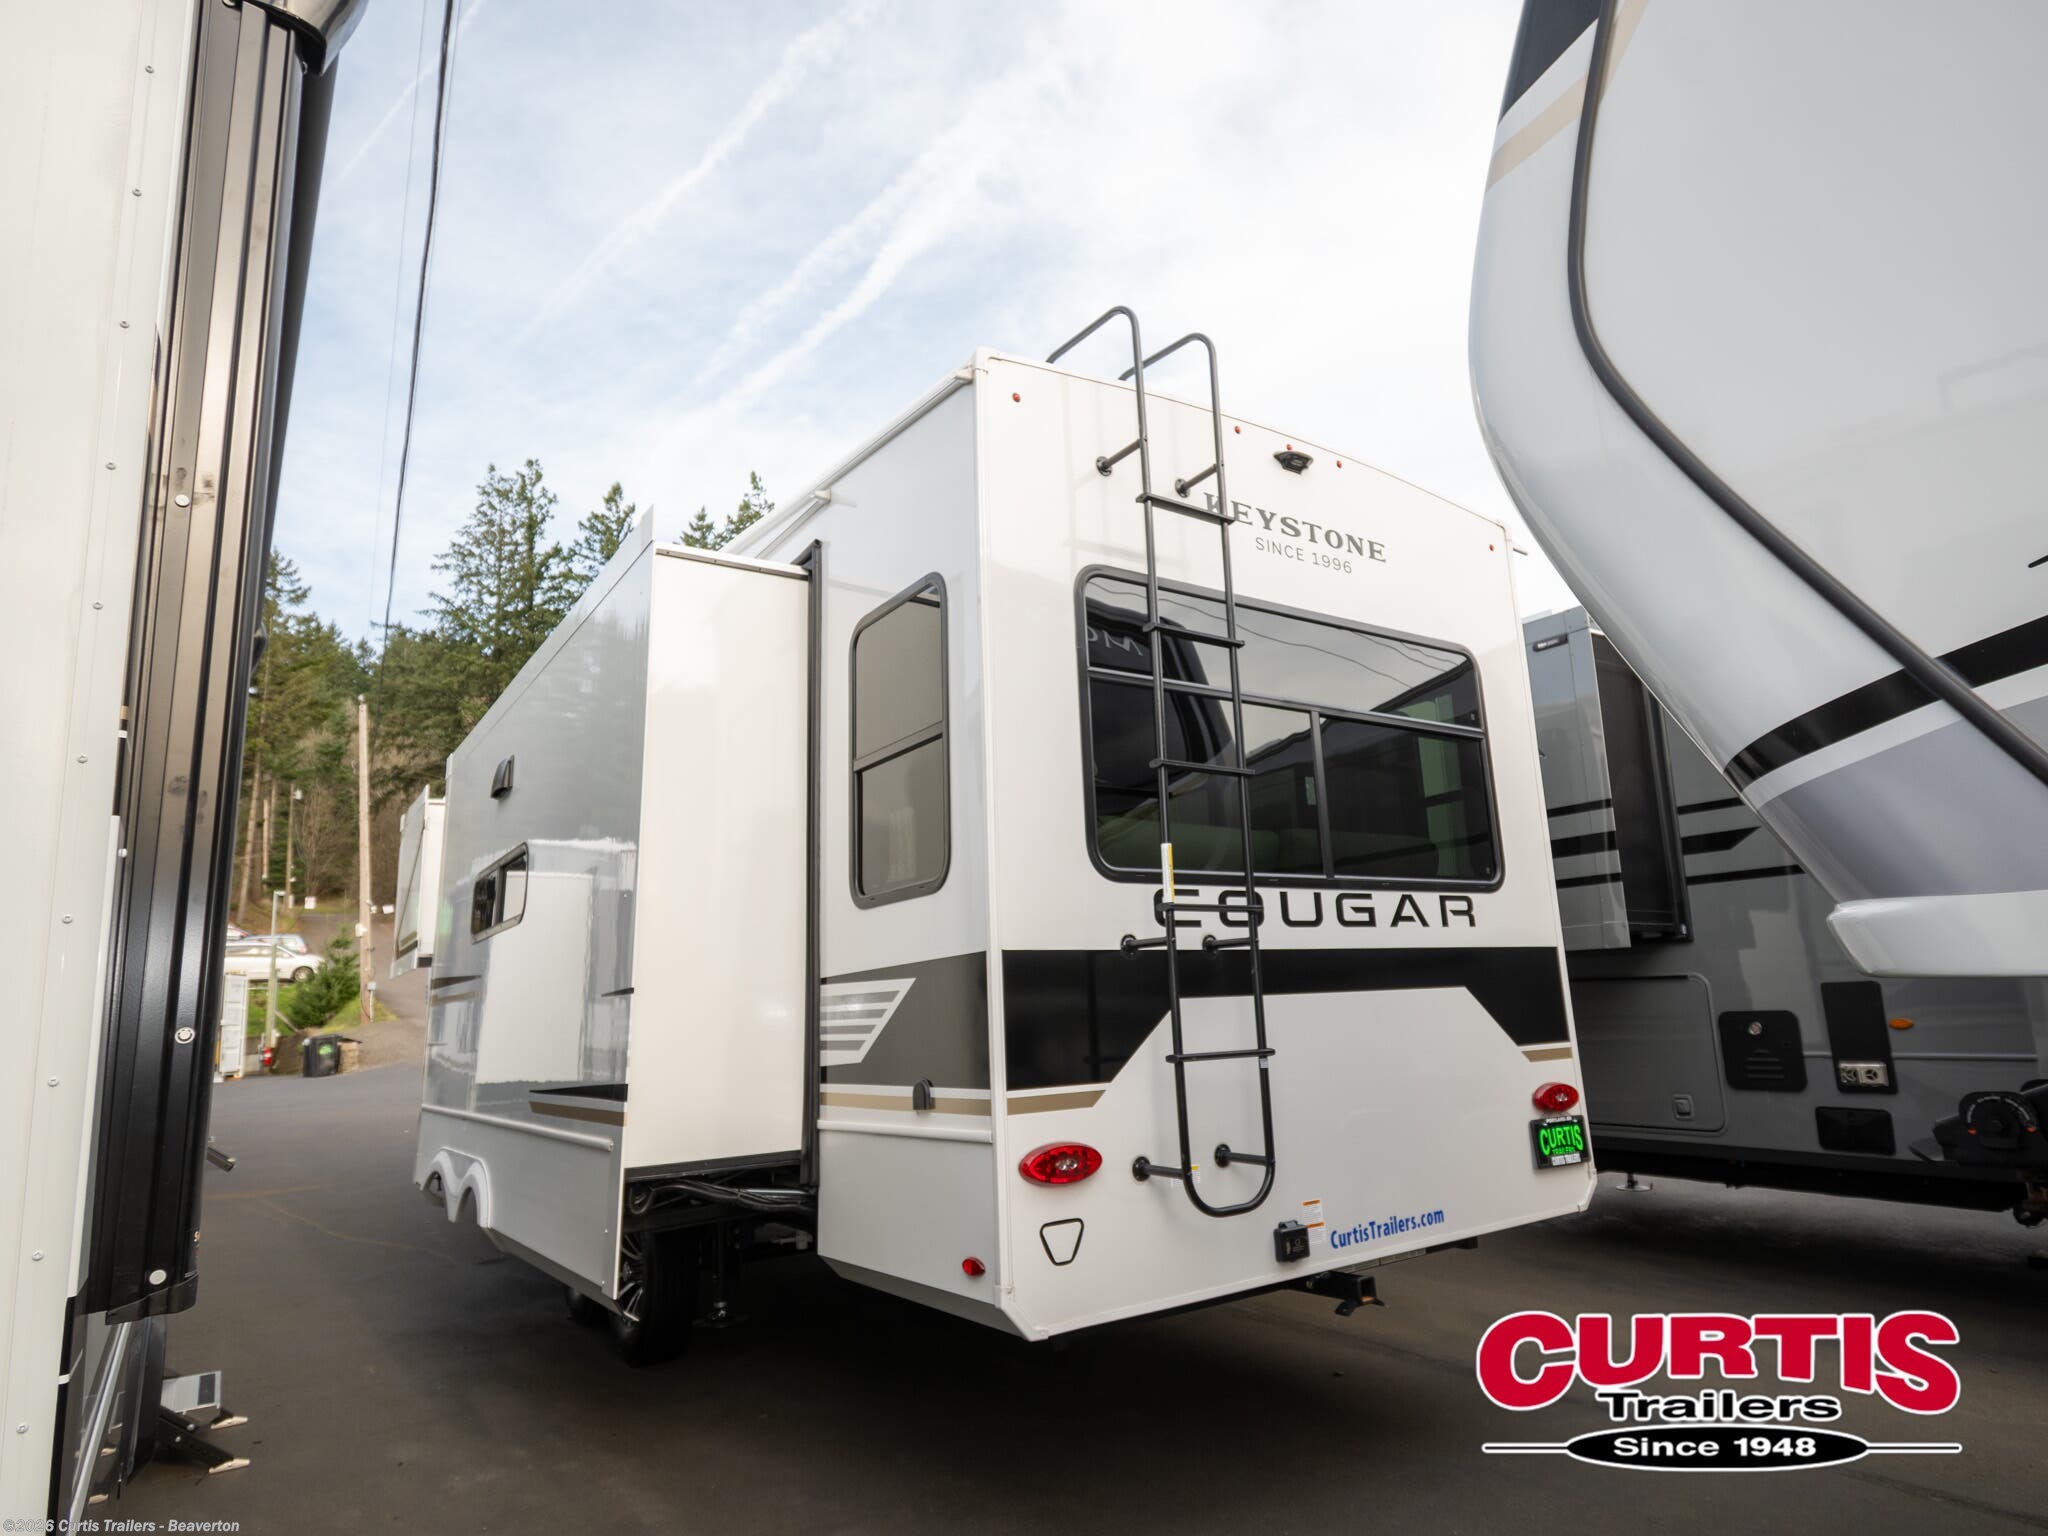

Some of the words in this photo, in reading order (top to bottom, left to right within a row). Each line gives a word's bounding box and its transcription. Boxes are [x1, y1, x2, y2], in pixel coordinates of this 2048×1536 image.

[1255, 536, 1304, 562] SINCE
[1311, 552, 1353, 574] 1996
[1153, 887, 1476, 928] COUGAR
[1540, 1124, 1584, 1156] CURTIS
[1330, 1209, 1446, 1250] CurtisTrailers.com
